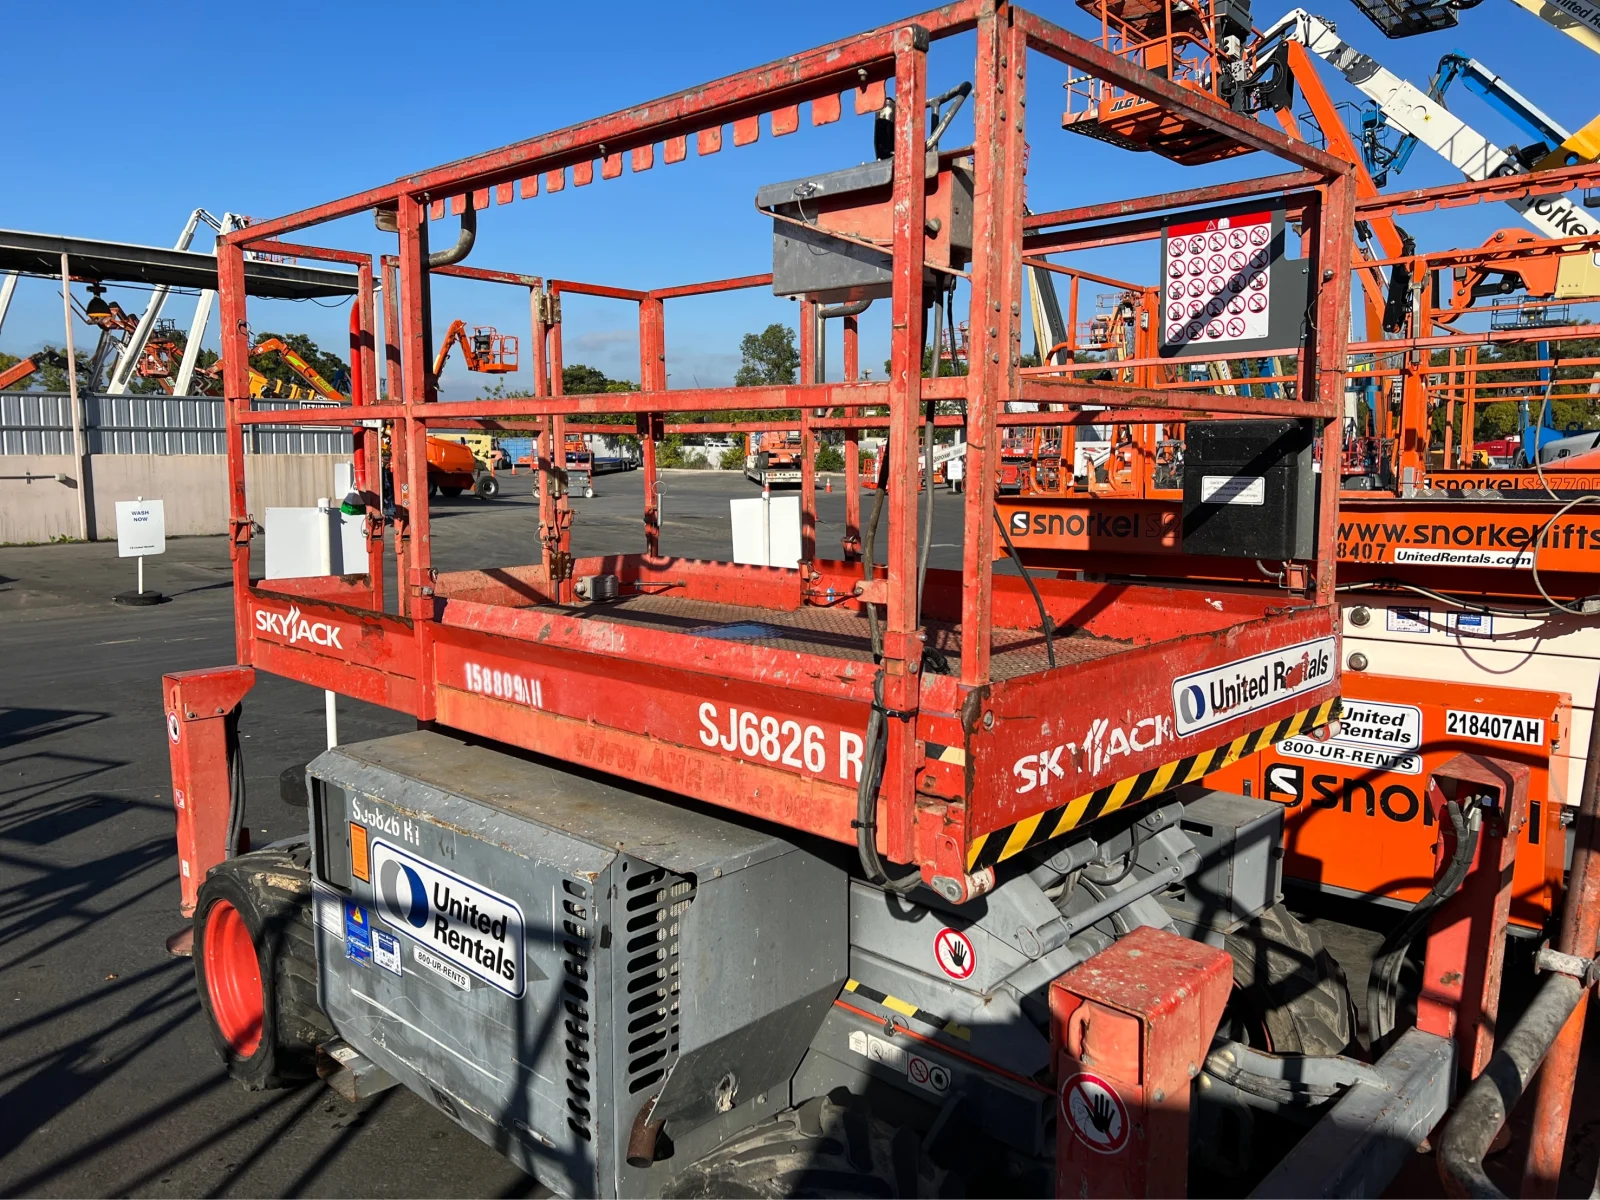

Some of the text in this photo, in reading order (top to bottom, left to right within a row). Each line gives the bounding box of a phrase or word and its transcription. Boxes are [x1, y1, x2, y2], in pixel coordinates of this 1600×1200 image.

[1556, 0, 1594, 18] nited
[1108, 96, 1135, 112] JLG
[1033, 513, 1139, 538] snorkel
[1145, 513, 1181, 538] S2
[1396, 550, 1532, 566] UnitedRentals.com
[255, 604, 344, 650] SKYJACK
[1210, 649, 1329, 711] United Rtals
[698, 702, 867, 783] SJ6826 R
[1341, 722, 1412, 744] Rentals
[1447, 712, 1540, 743] 218407AH
[1013, 713, 1175, 794] SKYJACK
[1282, 741, 1414, 770] 800-UR-RENTS
[433, 882, 508, 944] United
[433, 913, 516, 981] Rentals
[417, 951, 467, 986] 800-UR-RENTS
